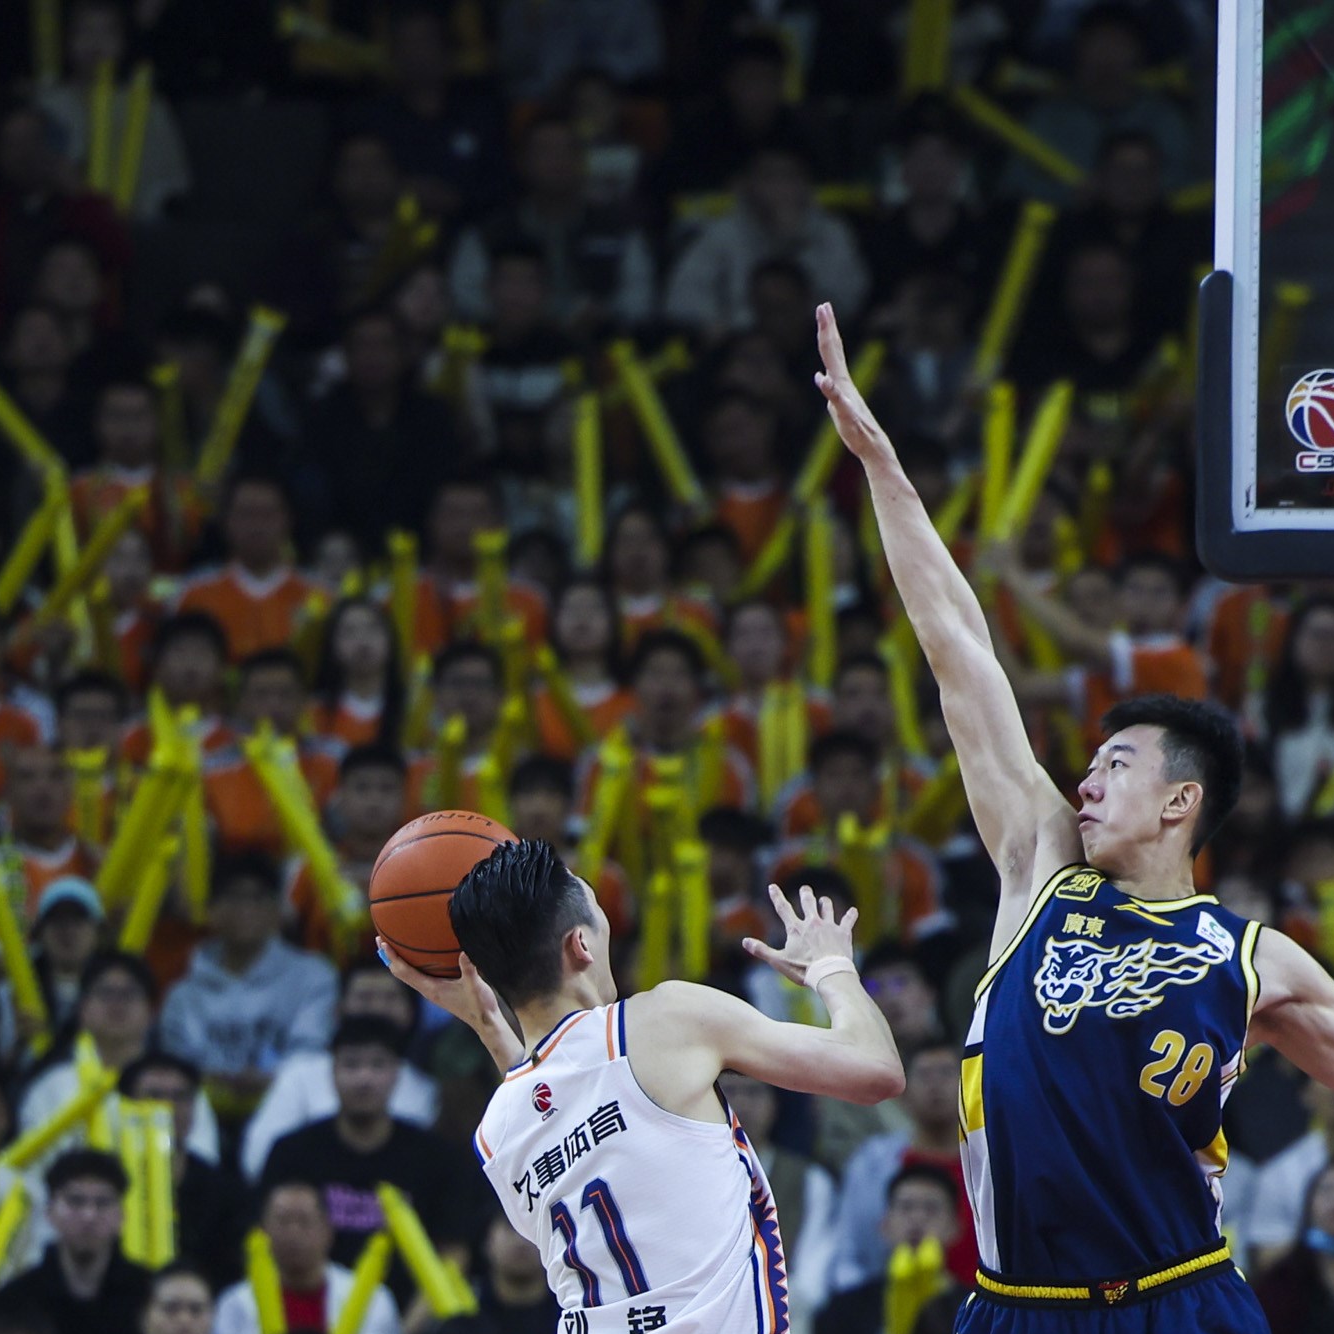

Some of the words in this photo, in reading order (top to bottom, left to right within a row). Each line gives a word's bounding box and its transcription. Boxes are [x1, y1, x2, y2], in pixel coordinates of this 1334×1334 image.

[1139, 1029, 1214, 1107] 28
[512, 1100, 628, 1213] 久事体育
[550, 1177, 652, 1309] 11
